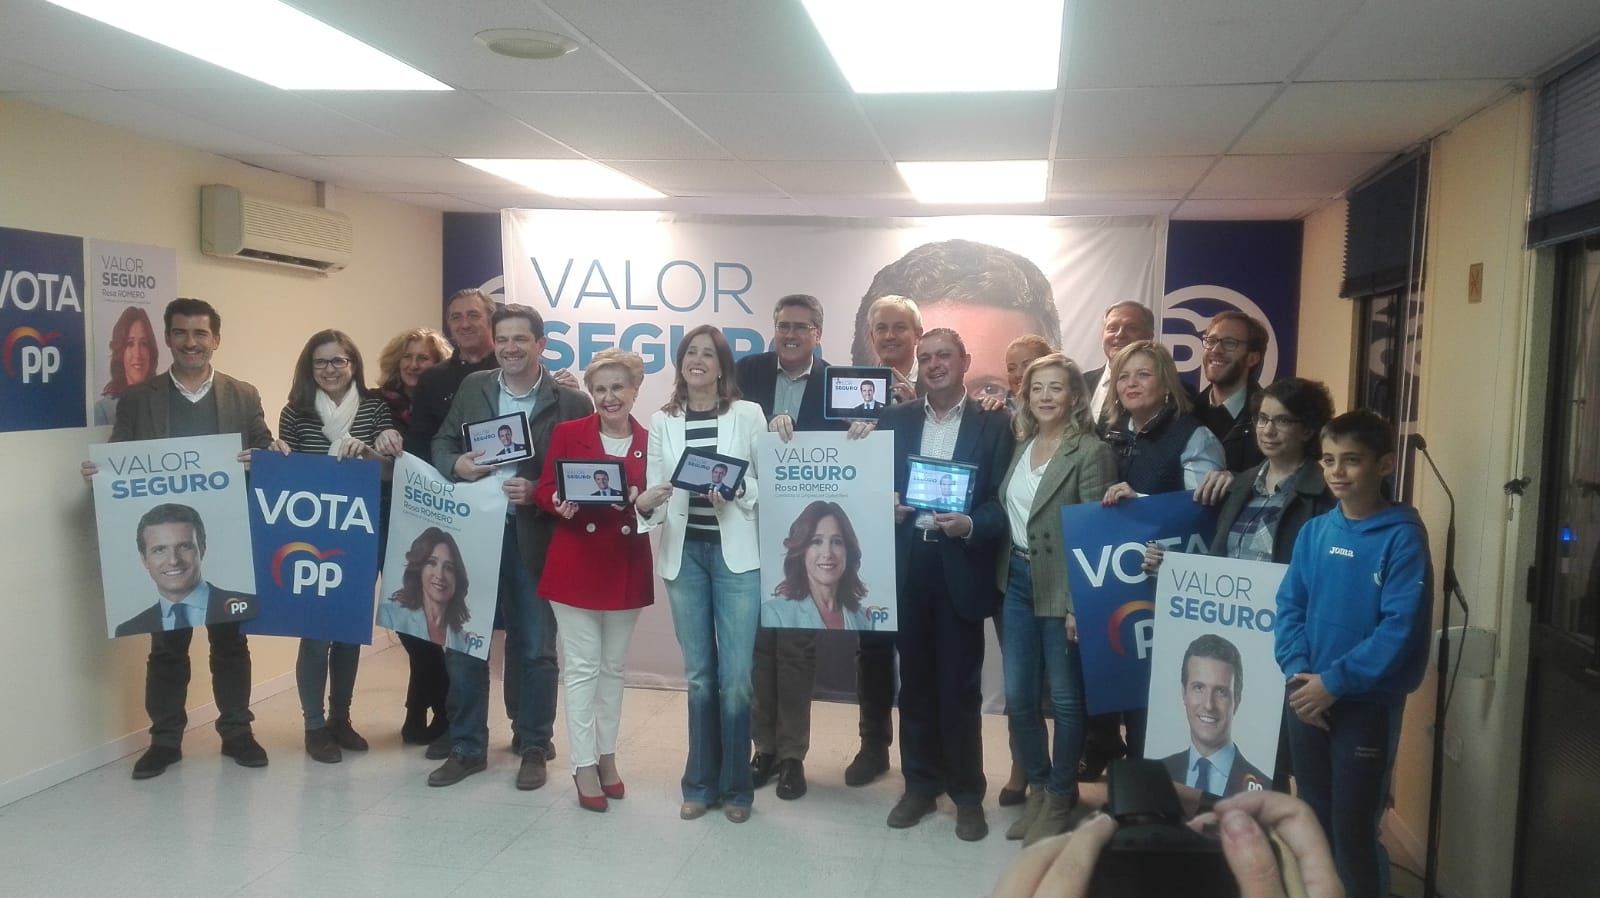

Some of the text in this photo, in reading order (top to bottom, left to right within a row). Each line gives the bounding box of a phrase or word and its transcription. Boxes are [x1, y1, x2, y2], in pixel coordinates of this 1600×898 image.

[101, 255, 144, 273] VALOR
[102, 271, 156, 290] SEGURO
[529, 256, 754, 315] VALOR
[108, 450, 201, 476] VALOR
[774, 447, 839, 463] VALOR
[111, 471, 230, 499] SEGURO
[405, 468, 456, 498] VALOR
[774, 465, 857, 481] SEGURO
[404, 485, 471, 517] SEGURO
[774, 483, 839, 492] Rosa ROMERO
[254, 487, 375, 534] VOTA
[1171, 568, 1252, 601] VALOR
[1168, 595, 1275, 632] SEGURO
